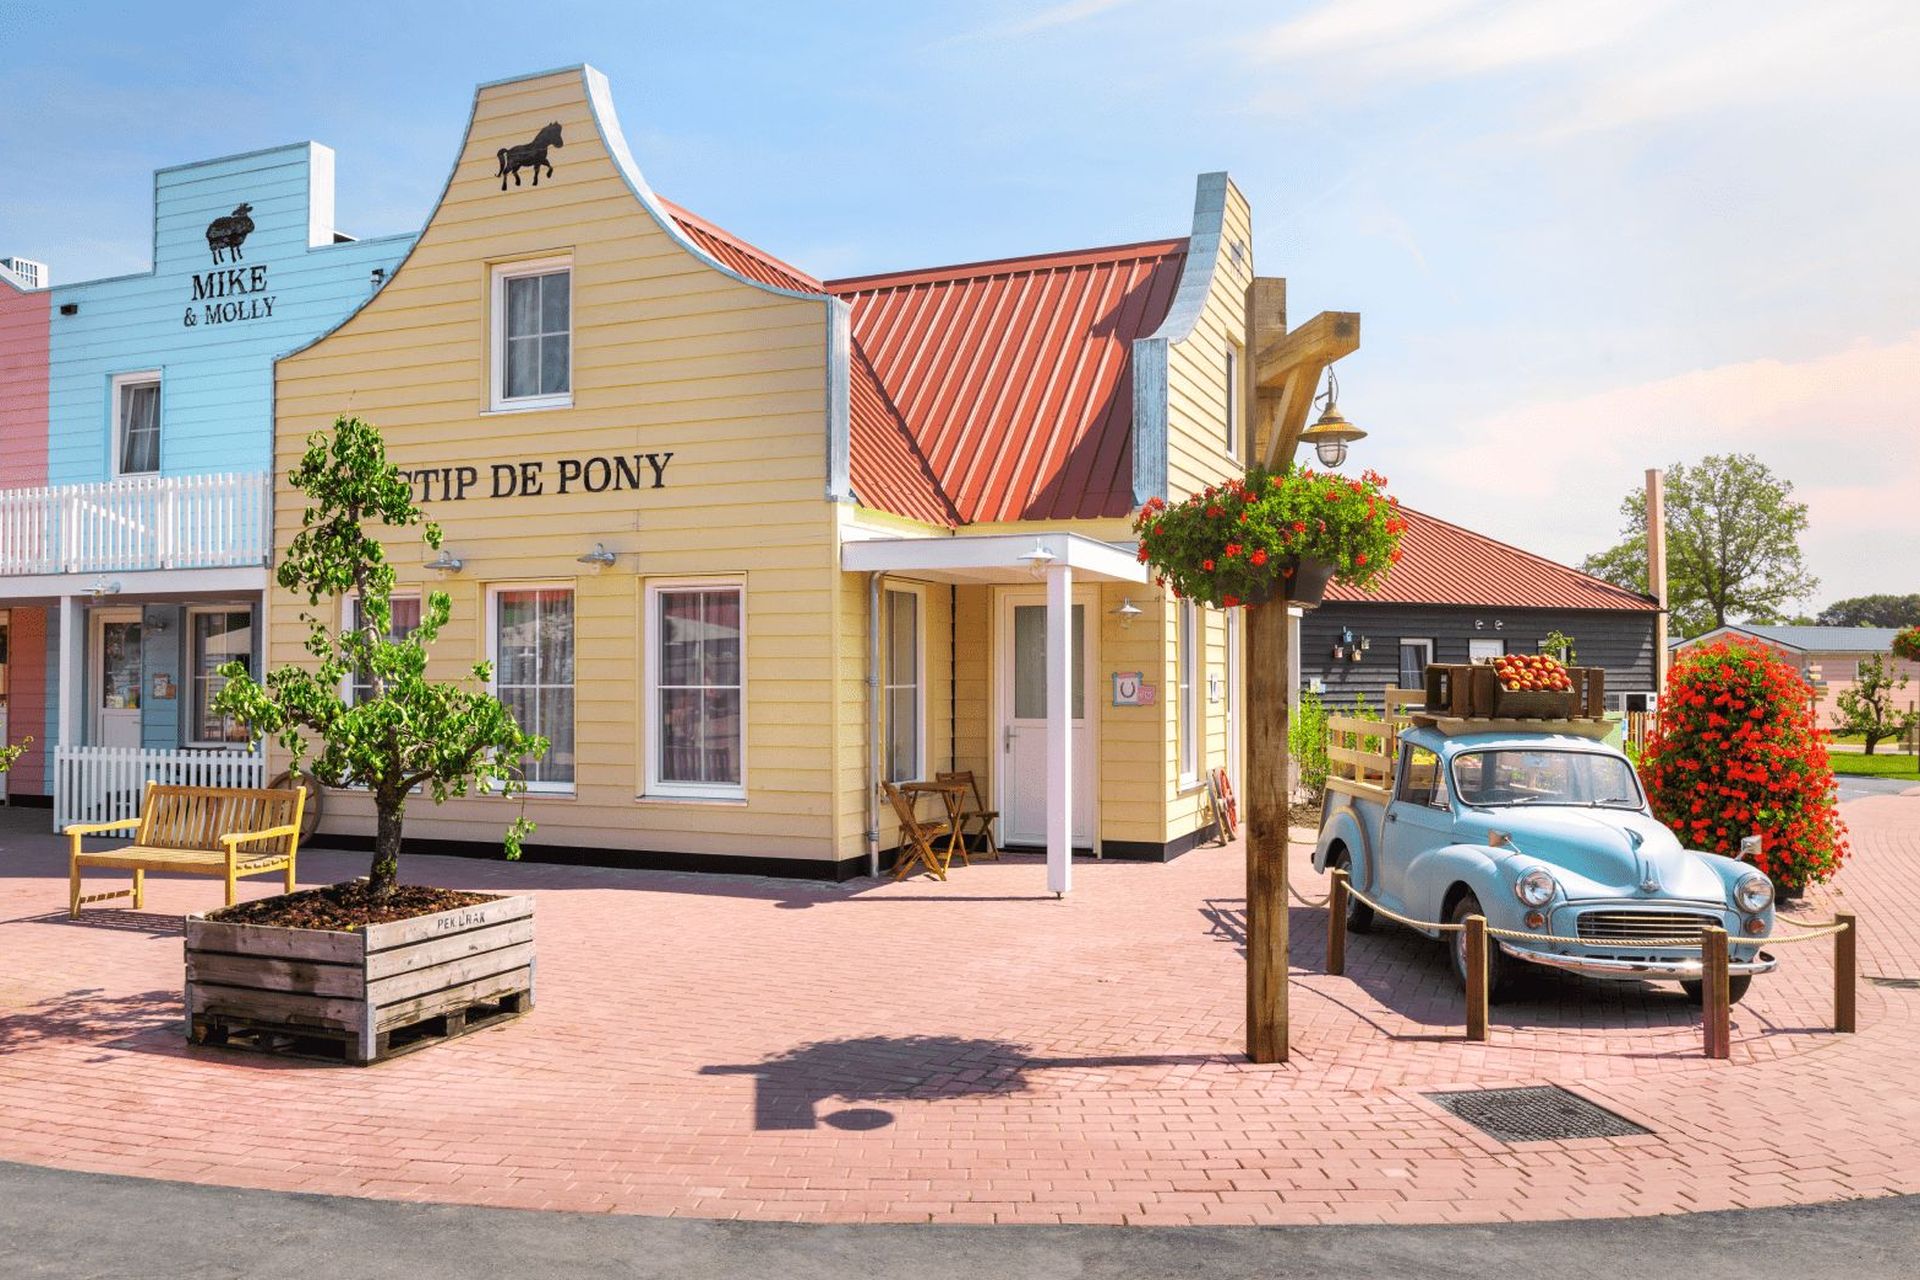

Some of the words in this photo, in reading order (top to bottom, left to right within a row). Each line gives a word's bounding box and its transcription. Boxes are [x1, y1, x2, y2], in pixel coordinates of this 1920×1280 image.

[192, 265, 267, 301] MIKE
[184, 307, 198, 327] &
[205, 296, 277, 325] MOLLY
[490, 462, 543, 498] DE
[557, 452, 674, 494] PONY
